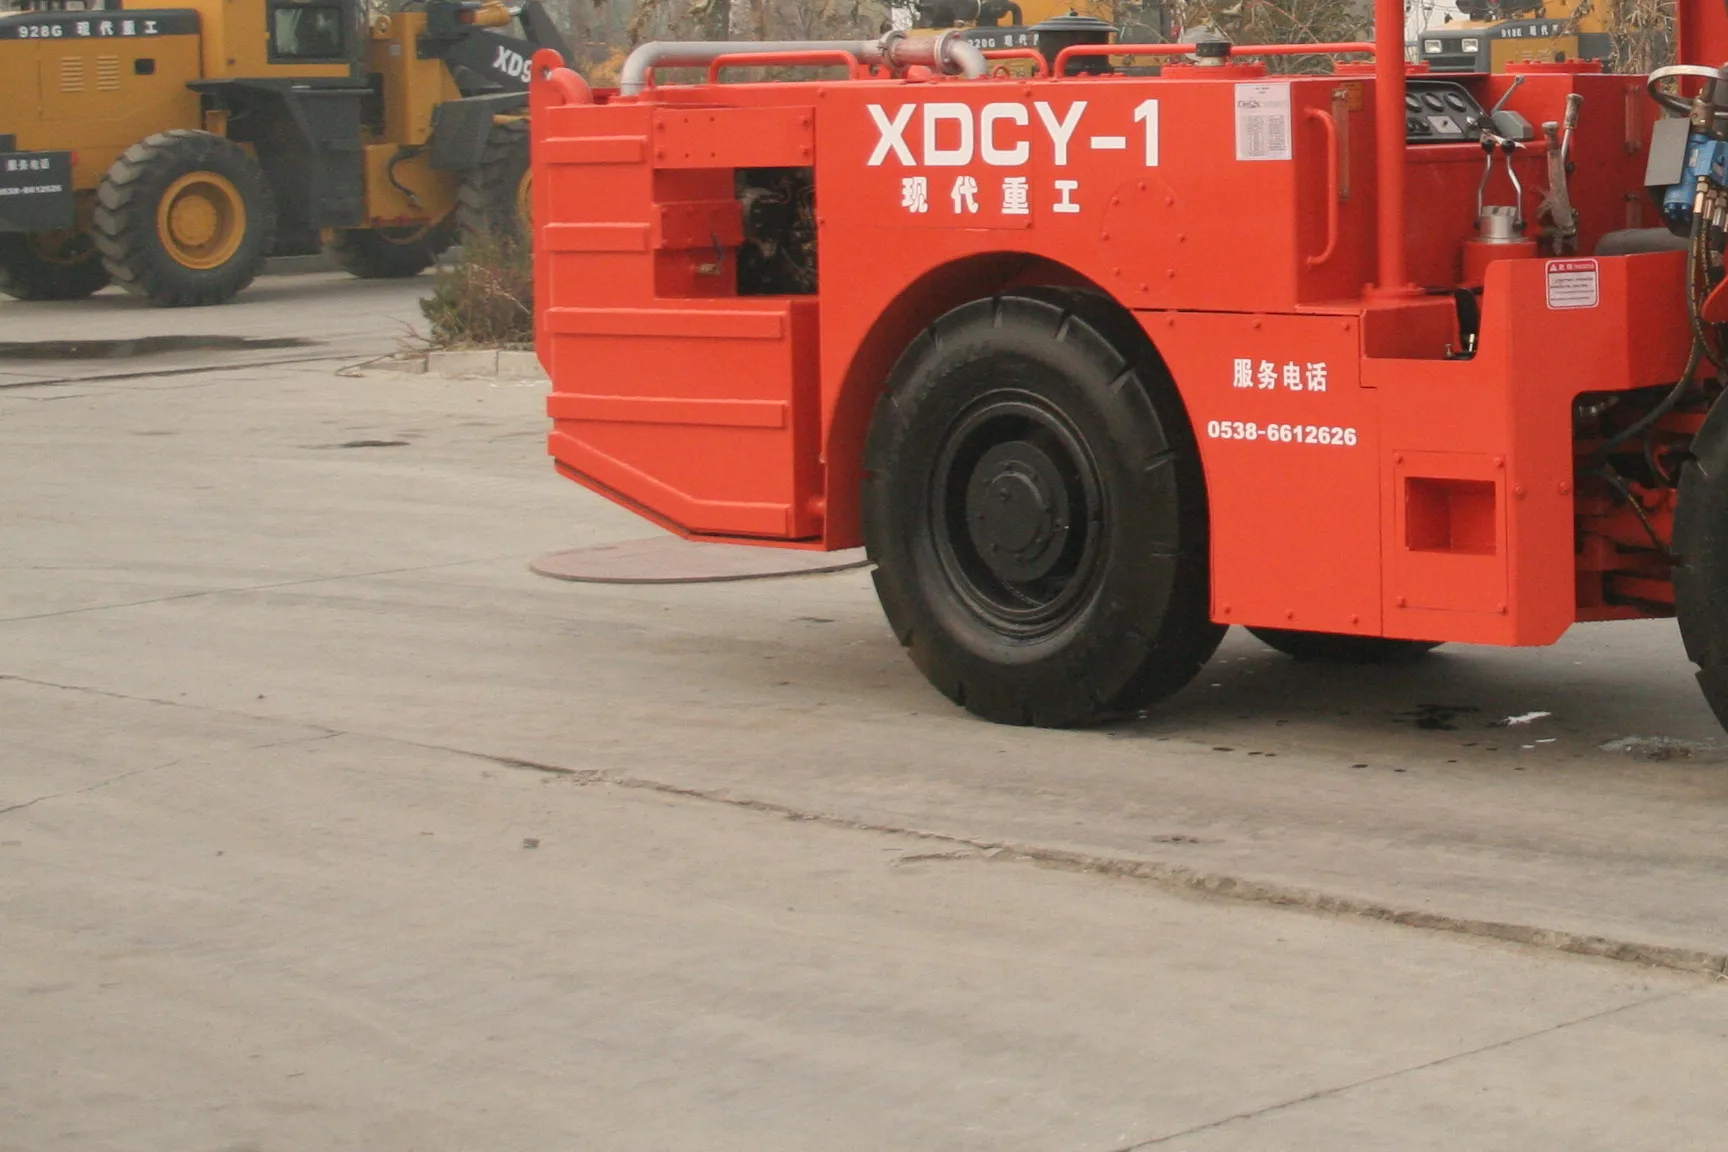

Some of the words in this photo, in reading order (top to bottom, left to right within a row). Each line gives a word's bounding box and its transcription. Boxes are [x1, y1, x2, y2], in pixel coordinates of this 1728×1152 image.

[18, 25, 62, 38] 928G
[866, 99, 1159, 166] XDCY-1
[901, 175, 1081, 215] 现代重工
[1233, 358, 1328, 392] 服务电话
[1207, 420, 1357, 446] 0538-6612626
